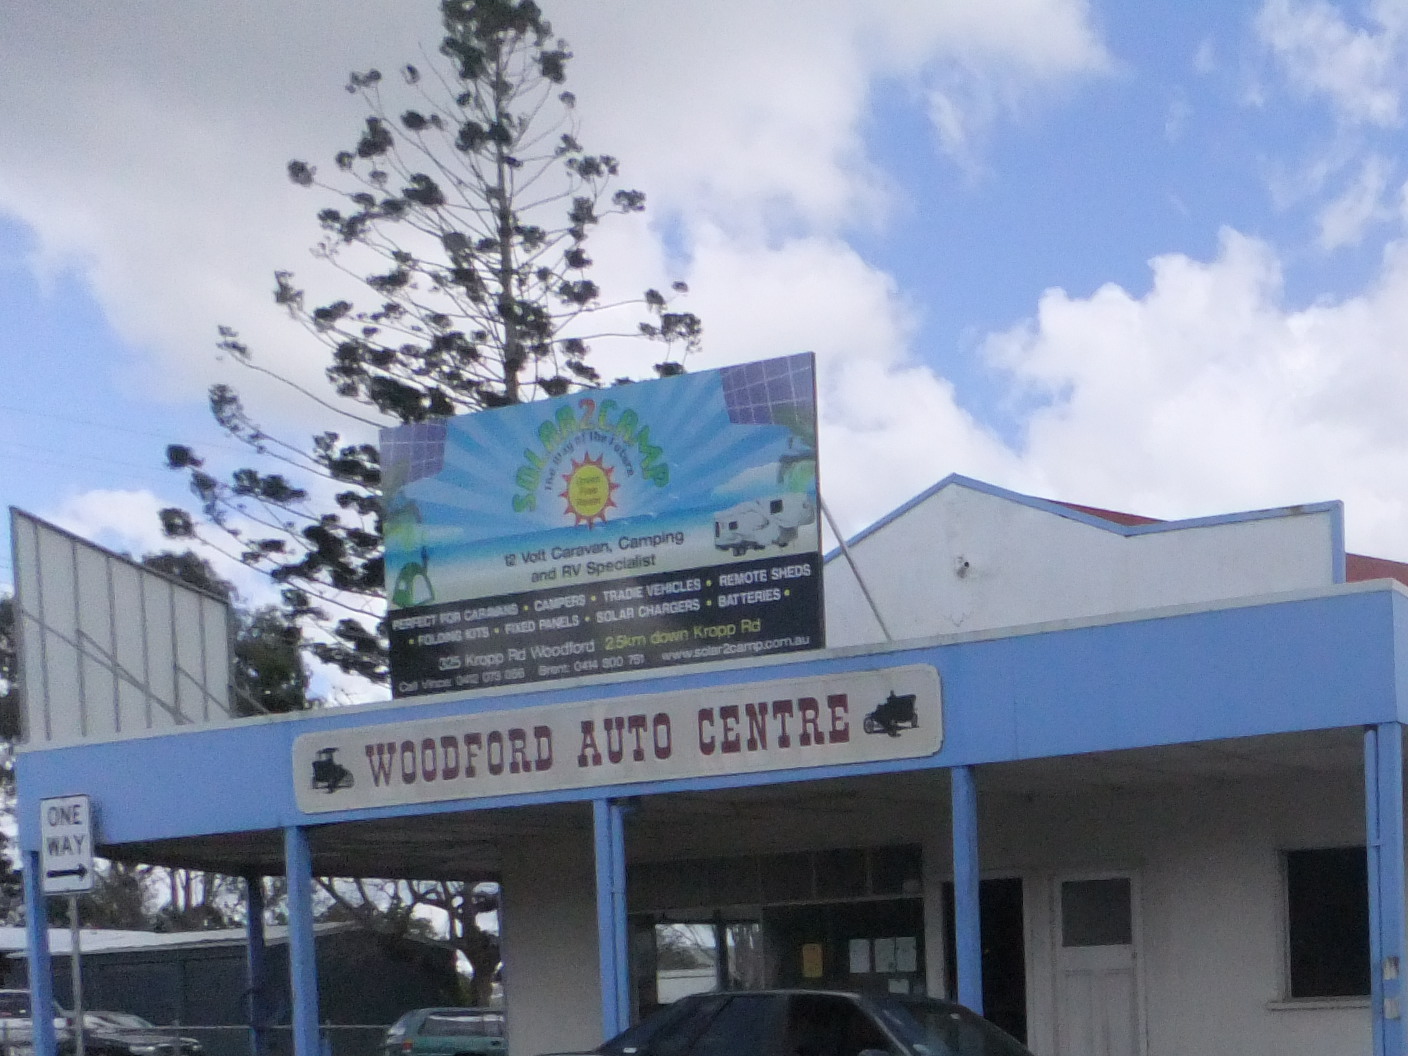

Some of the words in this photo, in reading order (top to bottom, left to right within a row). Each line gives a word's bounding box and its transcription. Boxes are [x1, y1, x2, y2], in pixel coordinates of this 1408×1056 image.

[521, 550, 547, 564] Volt
[618, 531, 685, 550] Camping
[531, 568, 557, 583] and
[562, 563, 582, 578] RV
[586, 553, 656, 576] Specialist
[439, 612, 461, 624] FOR
[534, 594, 586, 612] CAMPERS
[603, 586, 643, 601] TRADIE
[646, 578, 701, 596] VEHICLES
[719, 569, 768, 587] REMOTE
[771, 564, 811, 580] SHEDS
[504, 621, 535, 634] FIXED
[539, 615, 580, 630] PANELS
[596, 608, 634, 623] SOLAR
[638, 599, 700, 618] CHARGERS
[718, 589, 781, 608] BATTERIES
[508, 649, 526, 661] Rd
[531, 639, 595, 659] Woodford
[650, 628, 689, 644] down
[693, 622, 736, 640] Kropp
[741, 619, 761, 633] Rd
[662, 636, 810, 661] www.solar2camp.com.au
[365, 724, 554, 788] WOODFORD
[576, 712, 673, 769] AUTO
[697, 694, 850, 756] CENTRE
[48, 804, 82, 827] ONE
[47, 834, 85, 856] WAY
